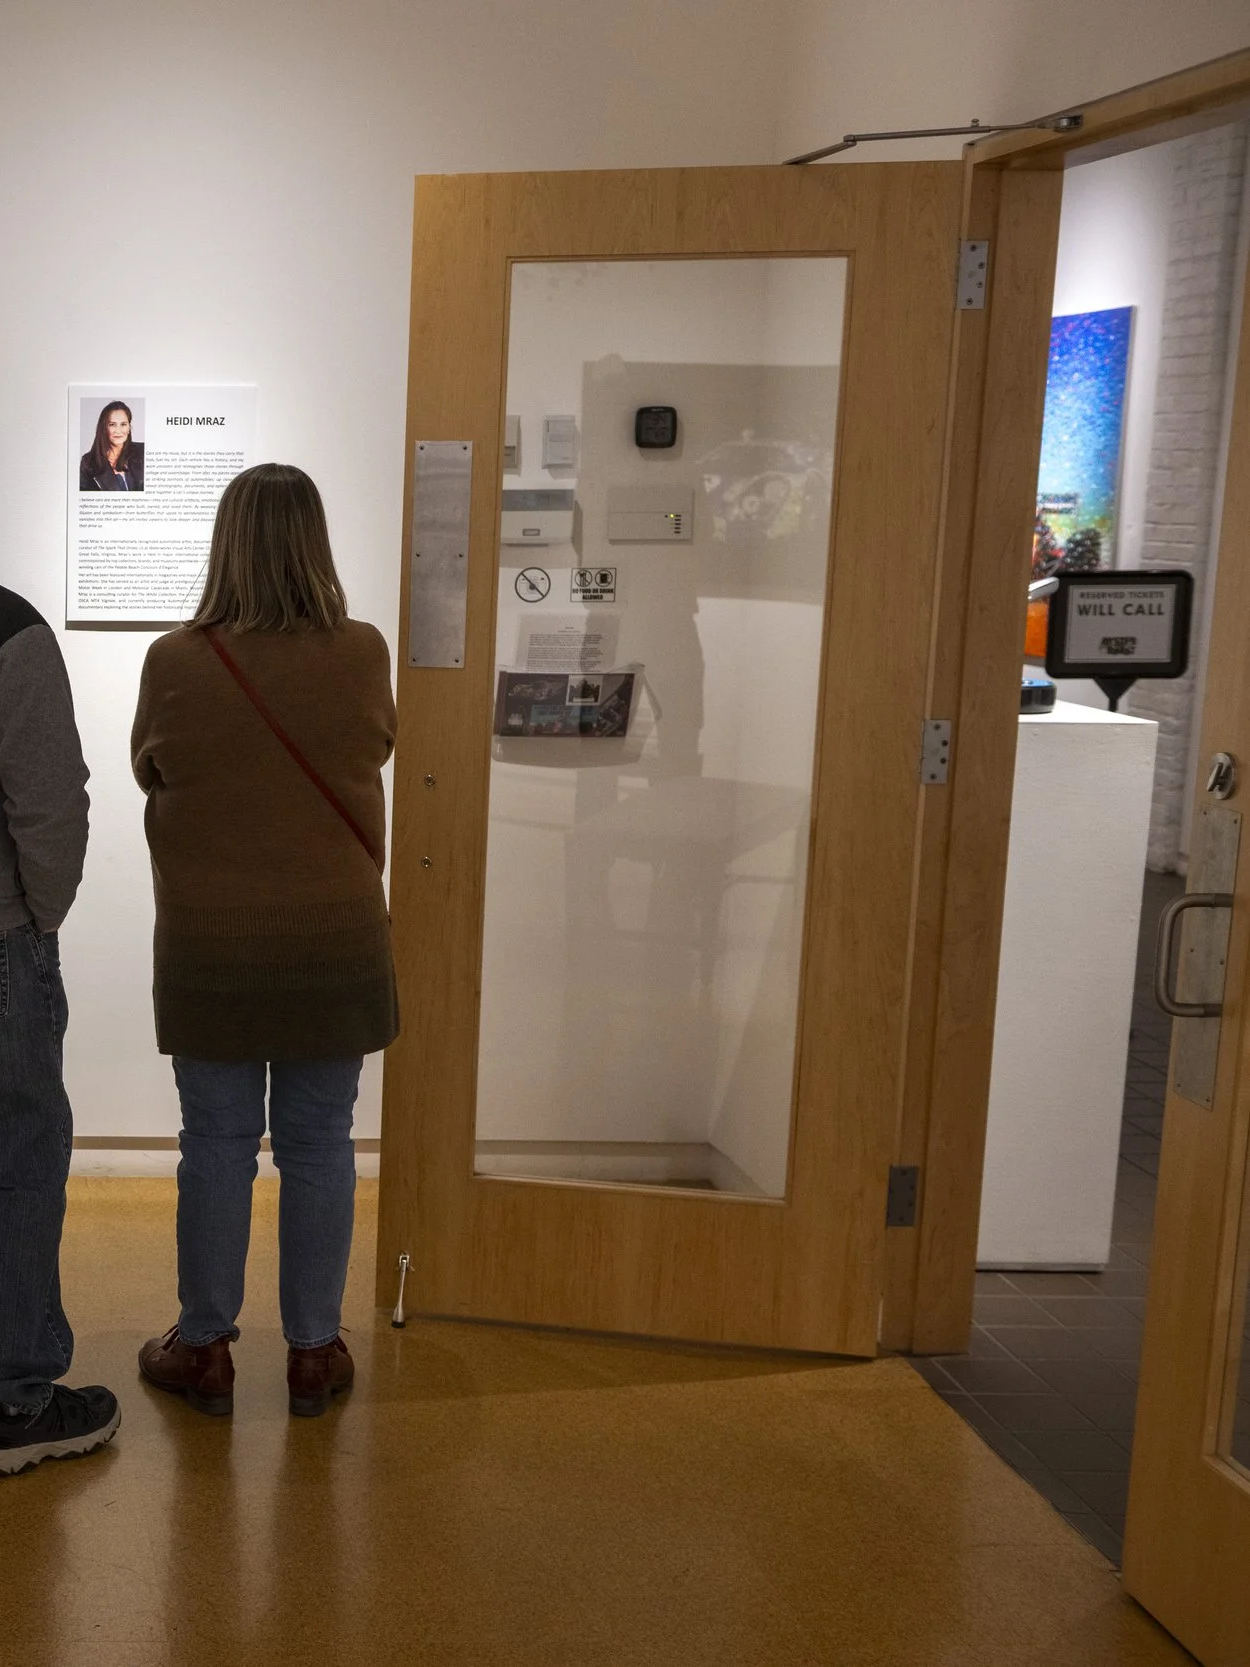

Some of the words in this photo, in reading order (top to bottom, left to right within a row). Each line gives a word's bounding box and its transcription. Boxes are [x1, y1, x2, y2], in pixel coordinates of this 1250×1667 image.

[166, 416, 193, 426] HEIDI
[196, 416, 225, 426] MRAZ
[1078, 604, 1114, 616] WILL
[1123, 603, 1164, 616] CALL
